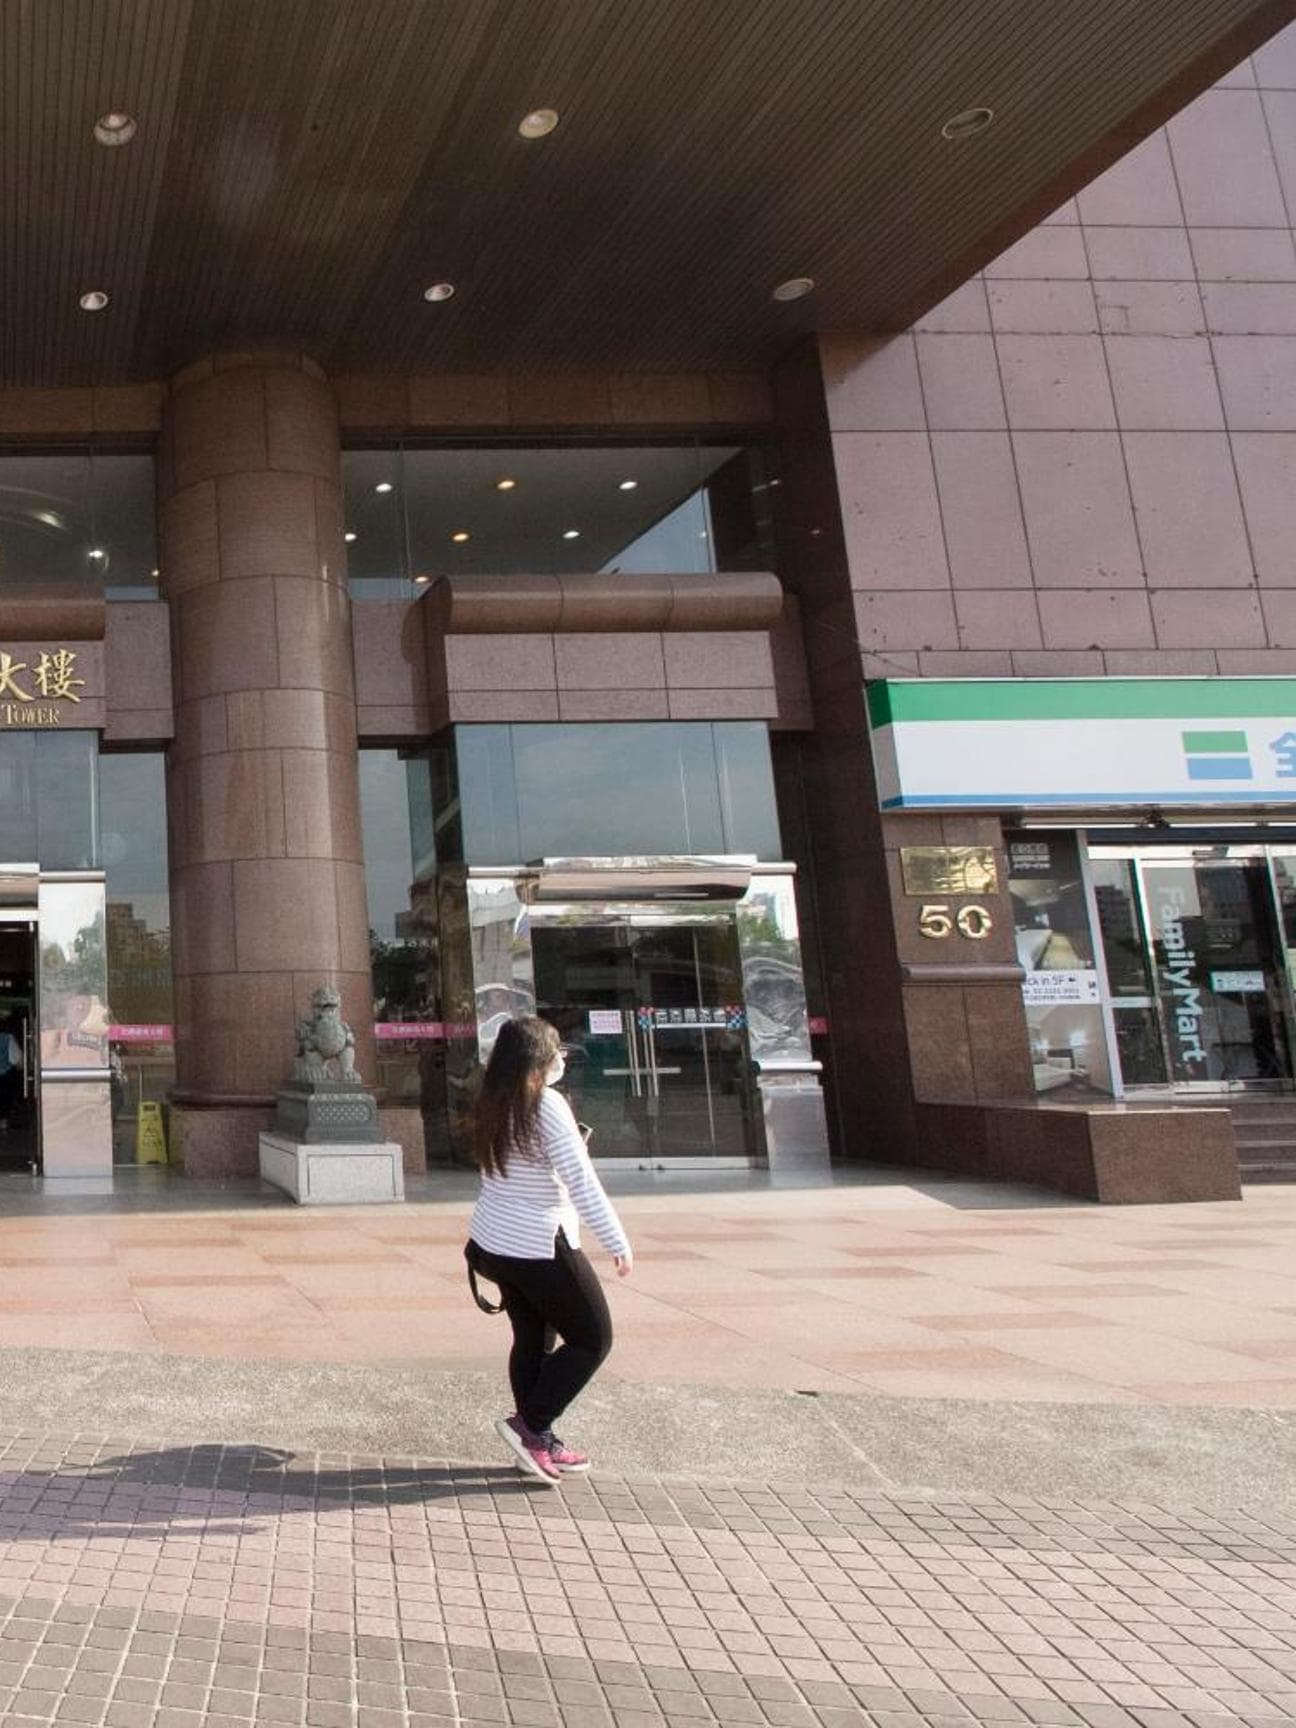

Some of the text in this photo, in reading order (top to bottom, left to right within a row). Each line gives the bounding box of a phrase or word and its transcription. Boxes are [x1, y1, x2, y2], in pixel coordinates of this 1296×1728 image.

[1, 704, 60, 726] TOWER
[920, 904, 993, 939] 50
[1158, 886, 1207, 1062] FamilyMart
